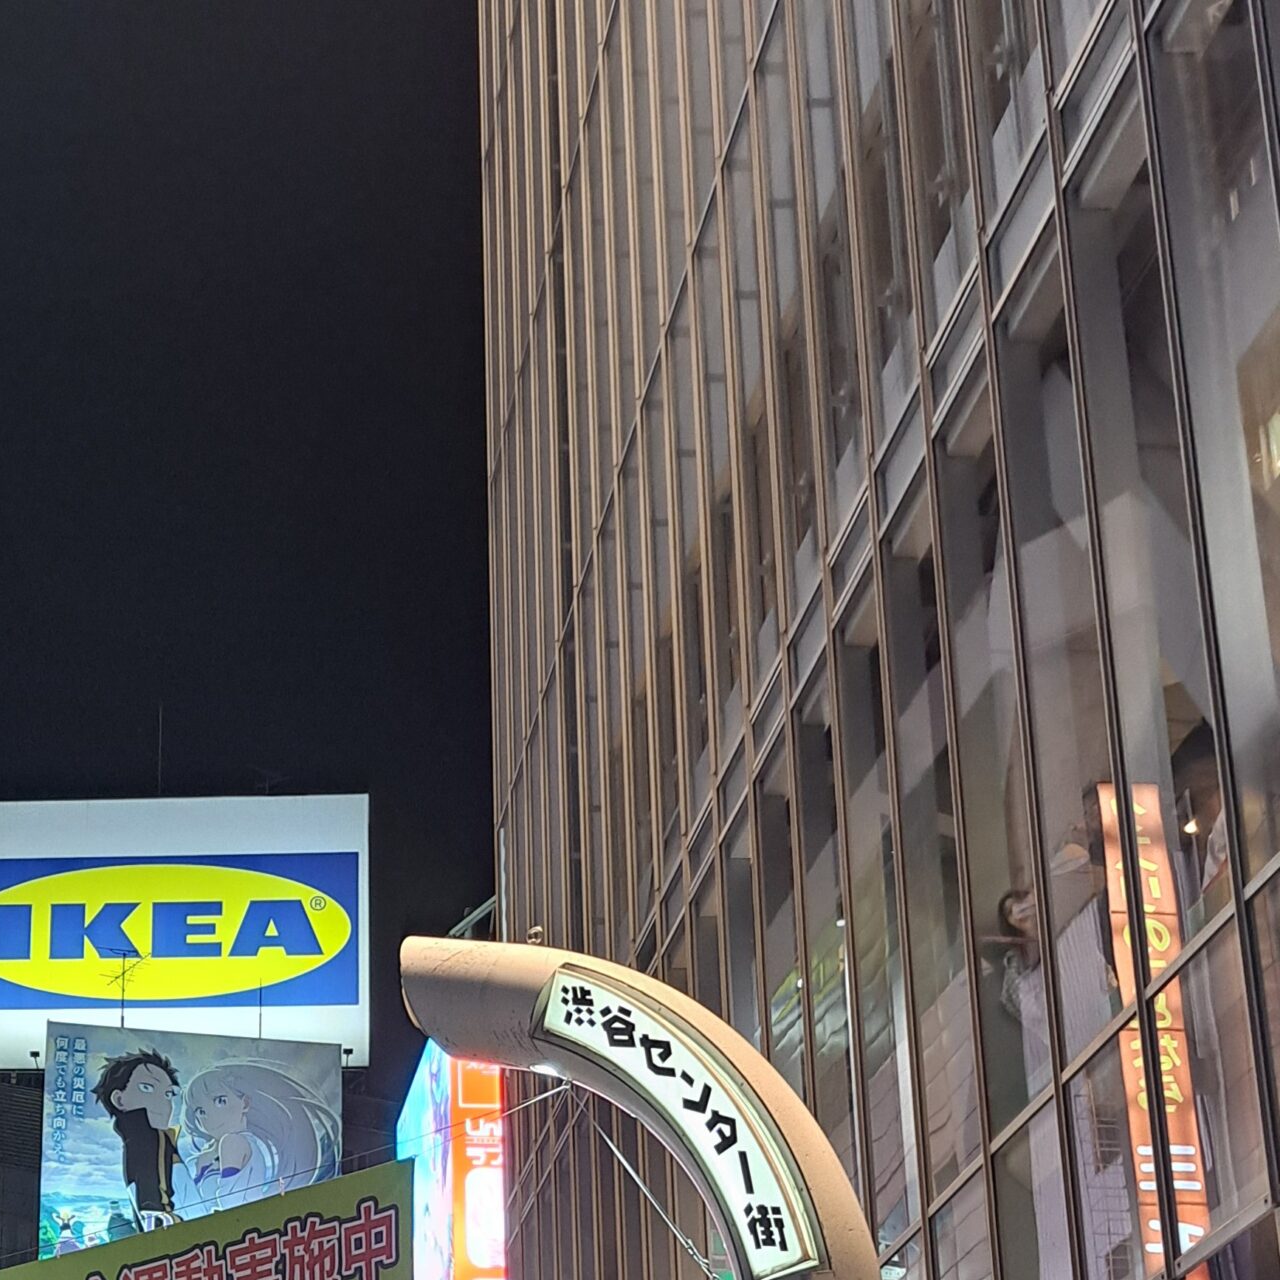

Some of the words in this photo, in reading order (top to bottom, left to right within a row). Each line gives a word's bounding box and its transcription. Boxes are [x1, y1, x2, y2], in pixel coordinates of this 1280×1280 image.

[560, 984, 788, 1252] 渋谷センター街
